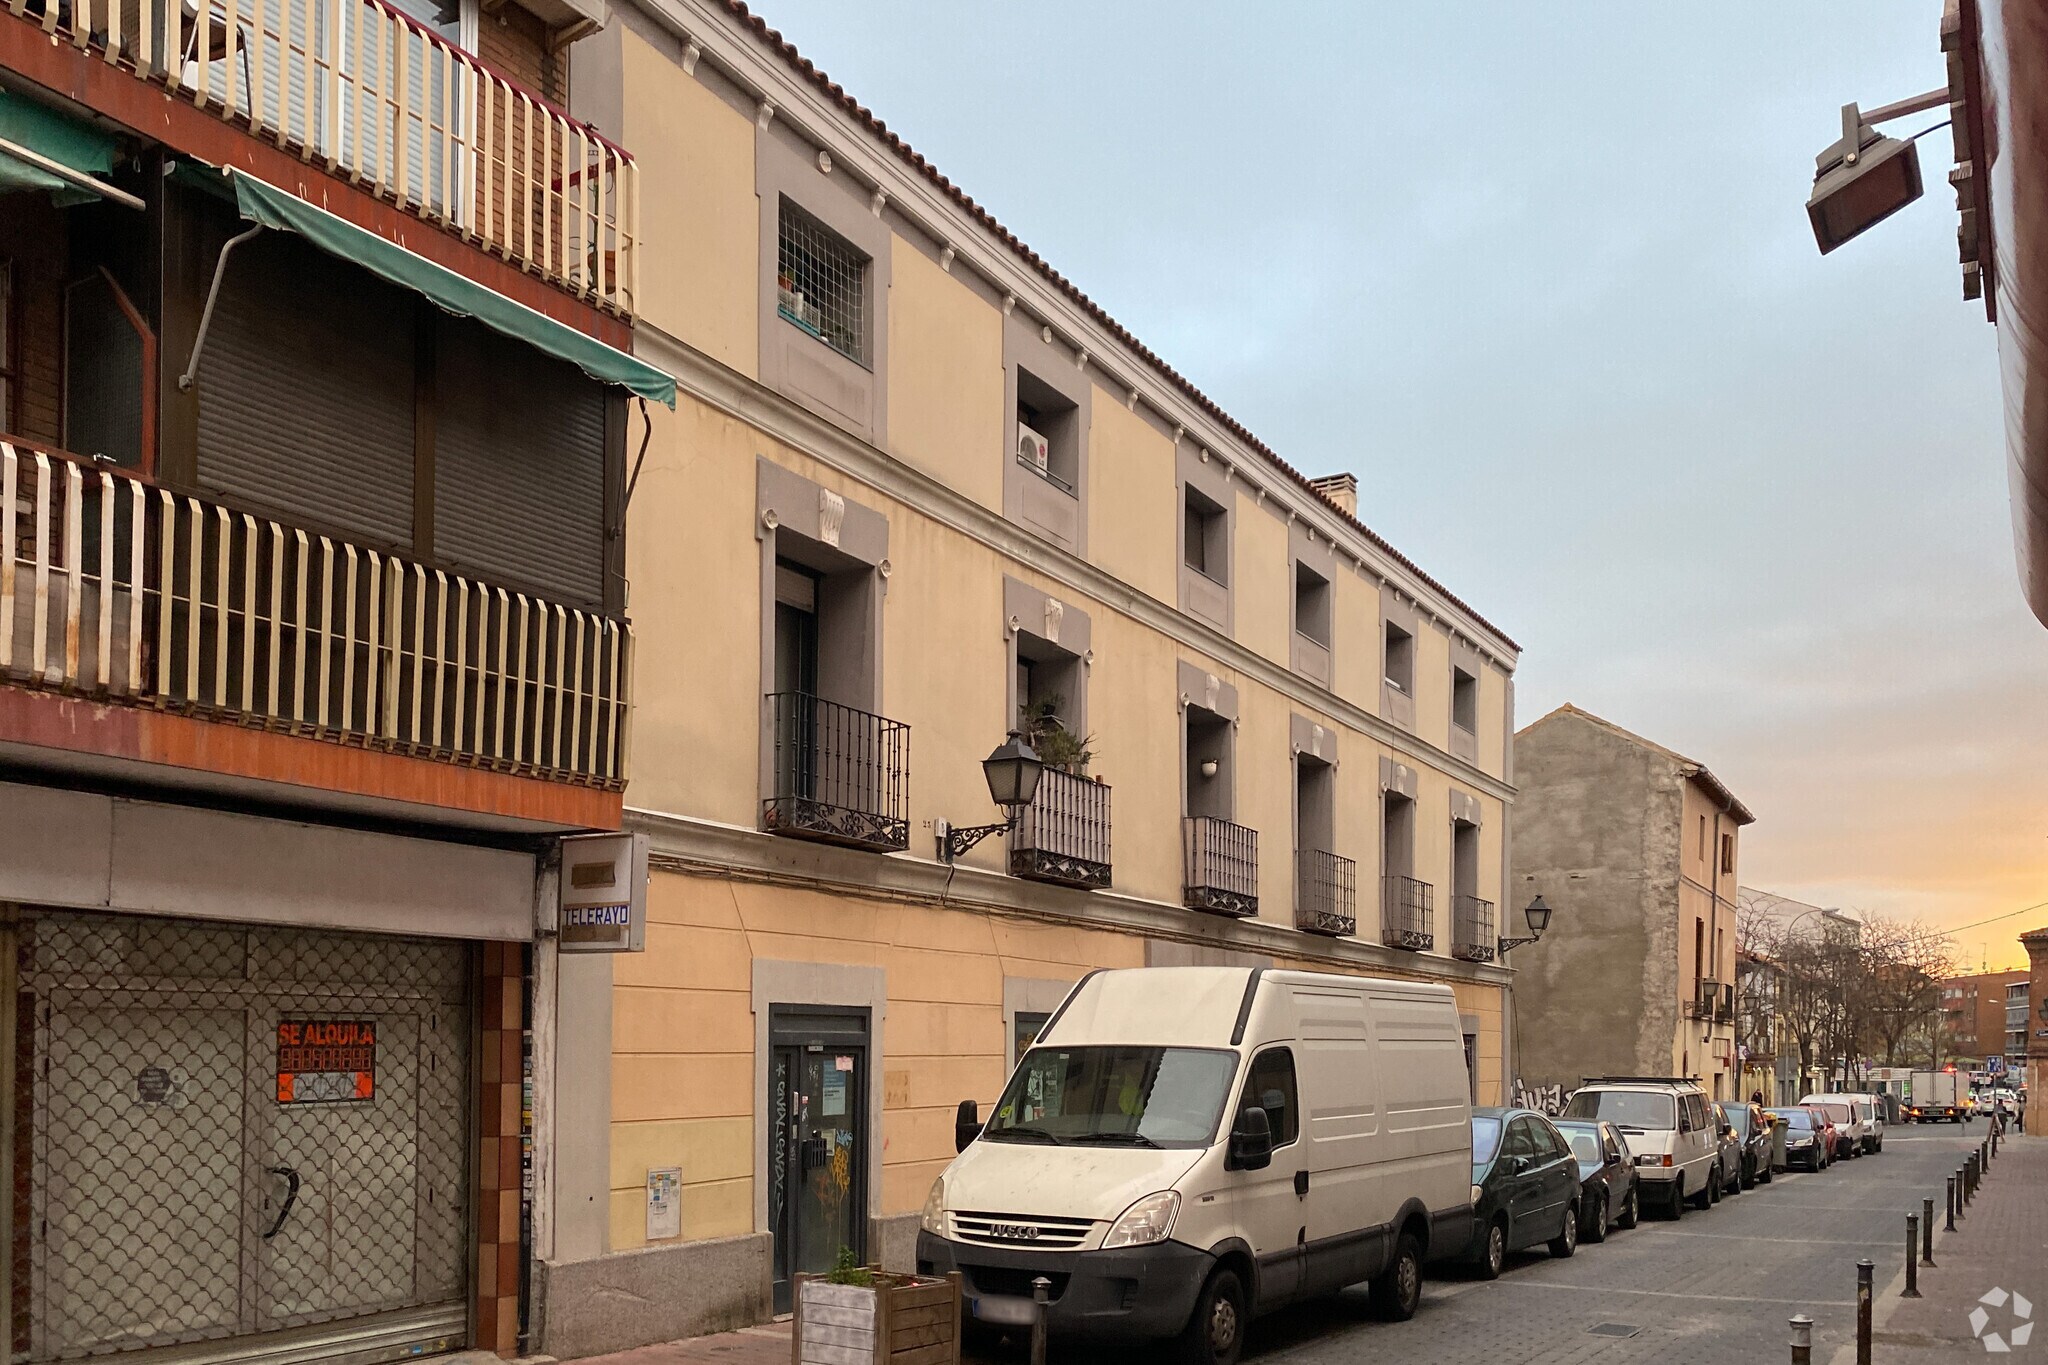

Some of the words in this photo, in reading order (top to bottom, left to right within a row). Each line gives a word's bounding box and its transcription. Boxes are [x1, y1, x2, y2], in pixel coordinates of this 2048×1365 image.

[563, 904, 629, 926] TELERAYO
[278, 1023, 301, 1045] SE
[304, 1022, 374, 1045] ALQUILA
[990, 1223, 1039, 1239] IVECO
